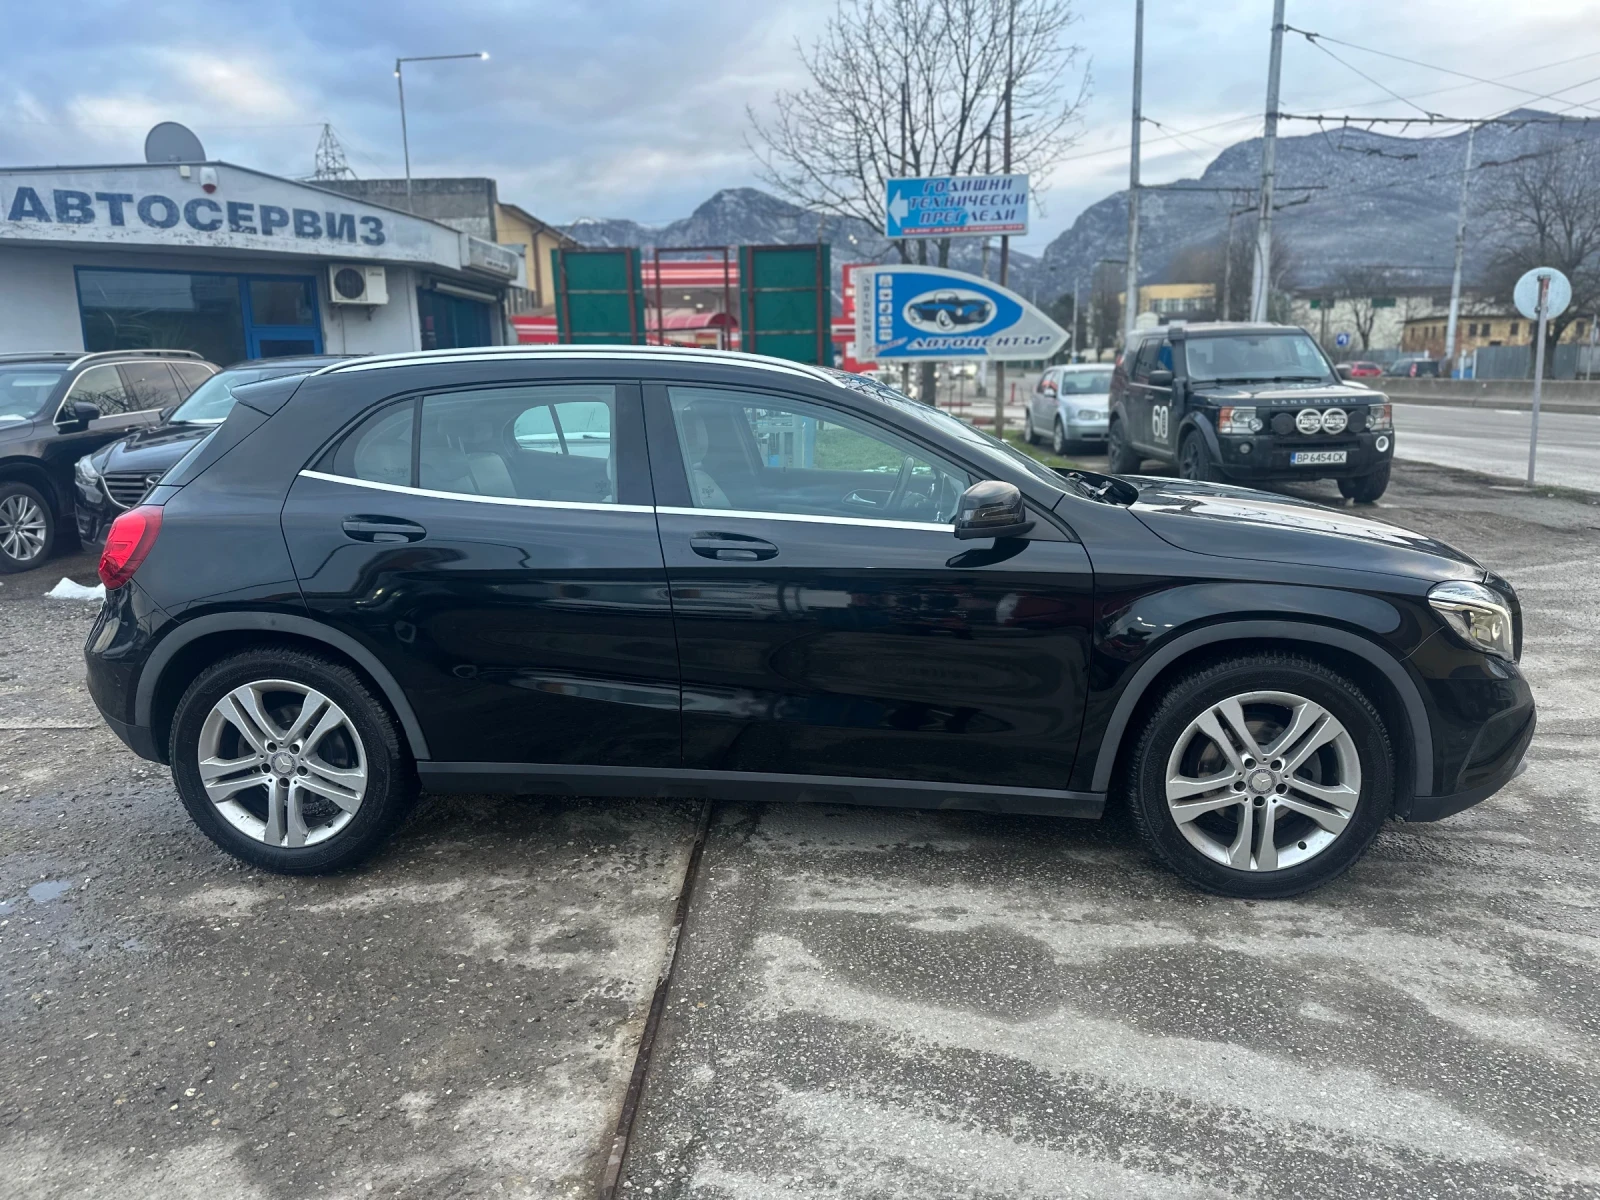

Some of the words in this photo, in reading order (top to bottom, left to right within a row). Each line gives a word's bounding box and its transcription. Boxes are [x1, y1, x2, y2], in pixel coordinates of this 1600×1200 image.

[923, 178, 1013, 194] ГОДИШНИ
[910, 193, 1027, 209] ТЕХНИЧЕСКИ
[7, 186, 386, 246] АВТОСЕРВИЗ
[1152, 405, 1169, 439] 60
[1296, 454, 1309, 463] BP
[1310, 453, 1332, 462] 6454
[1332, 452, 1344, 461] CK
